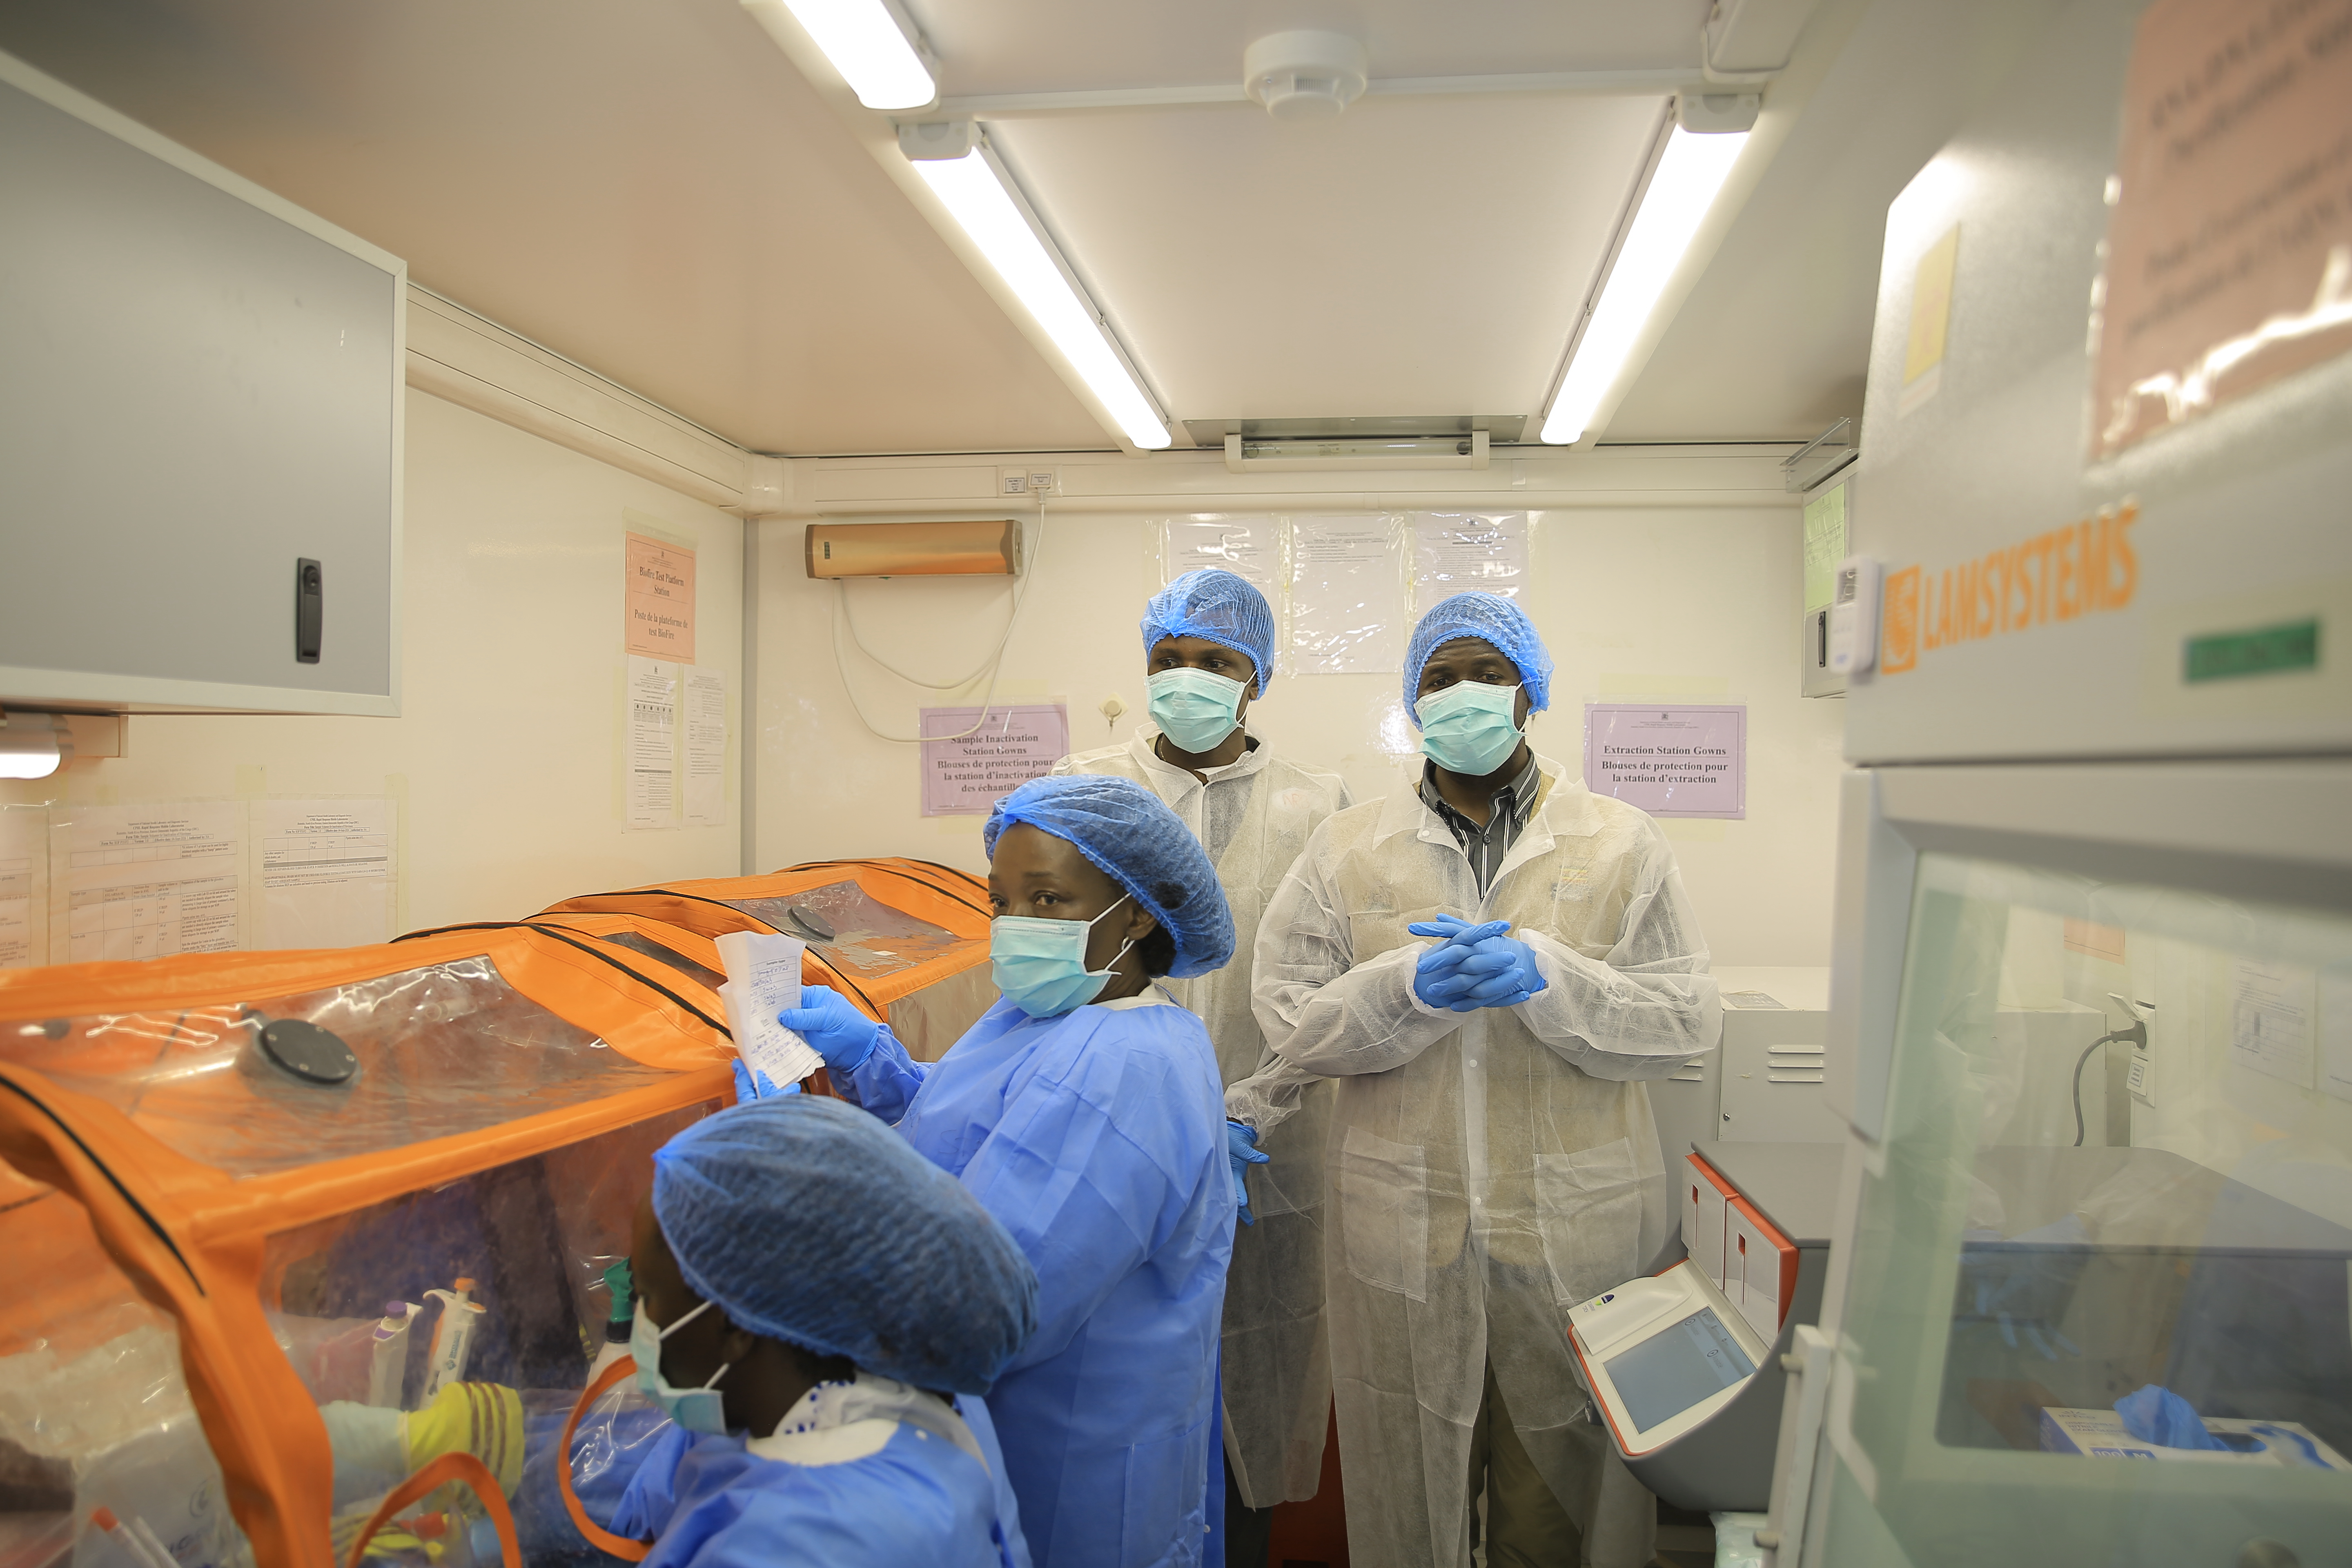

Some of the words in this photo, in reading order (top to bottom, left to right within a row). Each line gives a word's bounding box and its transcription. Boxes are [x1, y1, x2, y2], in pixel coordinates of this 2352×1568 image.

[640, 566, 655, 579] Biofire
[656, 571, 664, 581] Test
[666, 573, 684, 586] Platform
[1923, 508, 2138, 650] LAMSYSTEMS
[654, 585, 670, 597] Station
[635, 609, 646, 620] Poste
[647, 612, 653, 621] de
[654, 613, 657, 622] la
[659, 615, 682, 628] plateforme
[683, 619, 688, 628] de
[658, 628, 674, 639] BioFire
[951, 736, 983, 745] Sample
[986, 734, 1038, 743] Inactivation
[963, 747, 994, 755] Station
[997, 746, 1027, 755] Gowns
[1604, 746, 1654, 755] Extraction
[1657, 746, 1690, 755] Station
[1693, 746, 1726, 755] Gowns
[938, 760, 970, 768] Blouses
[973, 760, 983, 768] de
[986, 758, 1029, 769] protection
[1032, 760, 1054, 768] pour
[1602, 761, 1637, 769] Blouses
[1640, 762, 1651, 770] de
[1654, 762, 1702, 772] protection
[1705, 764, 1728, 773] pour
[955, 772, 984, 780] station
[1613, 774, 1620, 782] la
[1624, 774, 1655, 783] station
[962, 784, 976, 792] des
